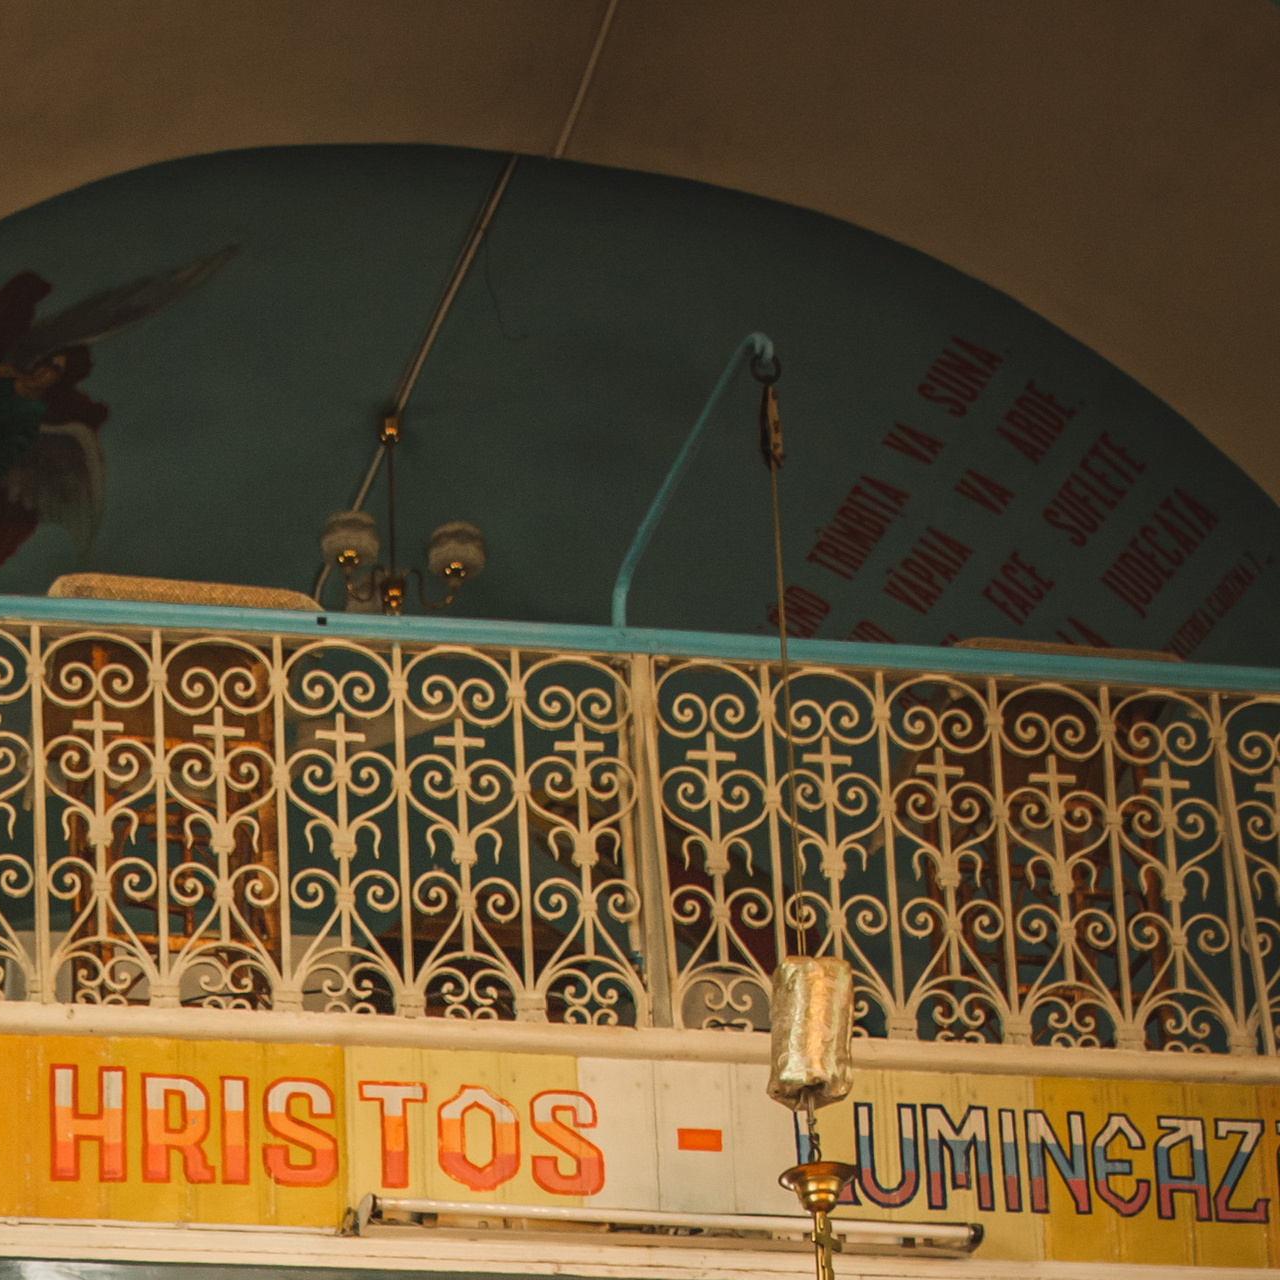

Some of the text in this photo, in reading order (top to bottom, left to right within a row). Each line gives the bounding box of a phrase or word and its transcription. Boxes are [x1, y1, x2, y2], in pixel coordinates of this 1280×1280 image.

[881, 421, 946, 465] VA
[953, 467, 1016, 516] VA
[981, 429, 1149, 626] FACE SUFLETE
[1100, 485, 1222, 619] JUDECATA
[49, 1063, 606, 1195] HRISTOS
[794, 1101, 1280, 1223] LUMINEAZ
